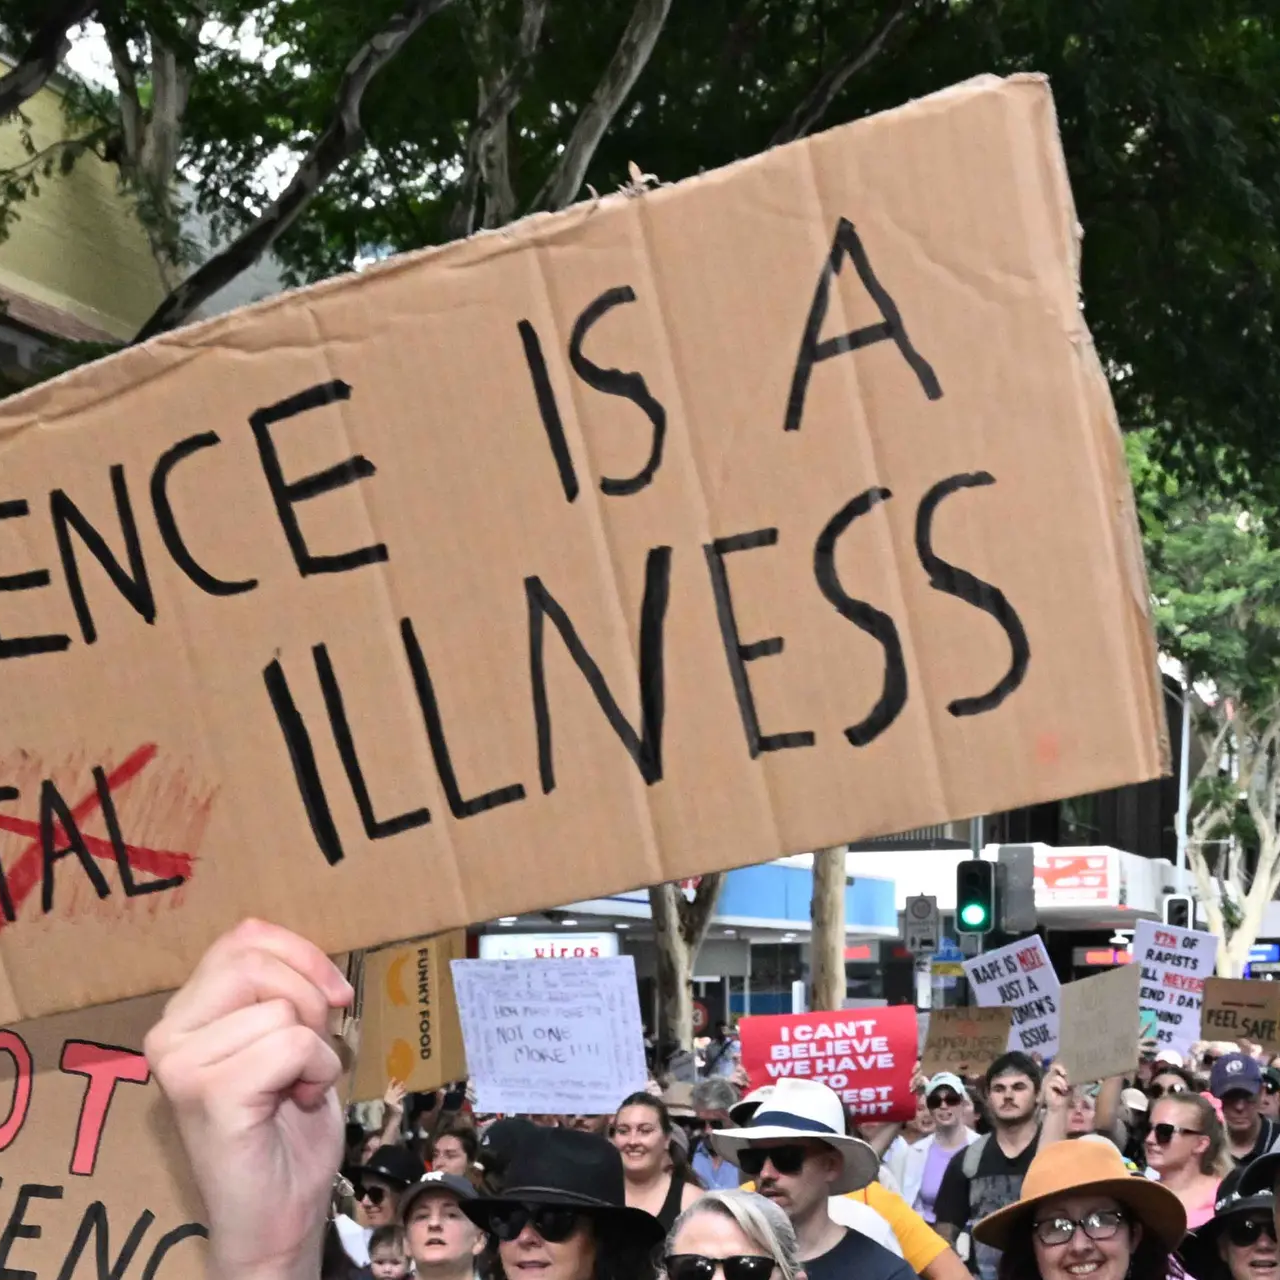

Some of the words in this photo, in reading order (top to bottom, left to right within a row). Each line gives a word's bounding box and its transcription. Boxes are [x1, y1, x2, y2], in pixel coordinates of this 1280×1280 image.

[517, 285, 667, 503] IS
[783, 216, 944, 432] A
[263, 470, 1032, 867] ILLNESS
[1182, 937, 1198, 949] OF
[971, 959, 1002, 984] RAPE
[1003, 956, 1017, 974] IS
[1016, 947, 1044, 971] NOT
[1145, 949, 1198, 970] RAPISTS
[417, 948, 430, 1005] FUNKY
[997, 979, 1024, 1003] JUST
[1028, 976, 1039, 992] A
[1177, 995, 1202, 1009] DAY
[419, 1011, 431, 1060] FOOD
[496, 1025, 523, 1044] NOT
[781, 1027, 789, 1041] I
[794, 1020, 877, 1041] CAN'T
[1207, 1009, 1239, 1029] FEEL
[1237, 1018, 1277, 1041] SAFE
[771, 1037, 888, 1060] BELIEVE
[765, 1061, 811, 1077] WE
[816, 1053, 894, 1073] HAVE
[811, 1075, 848, 1088] TO
